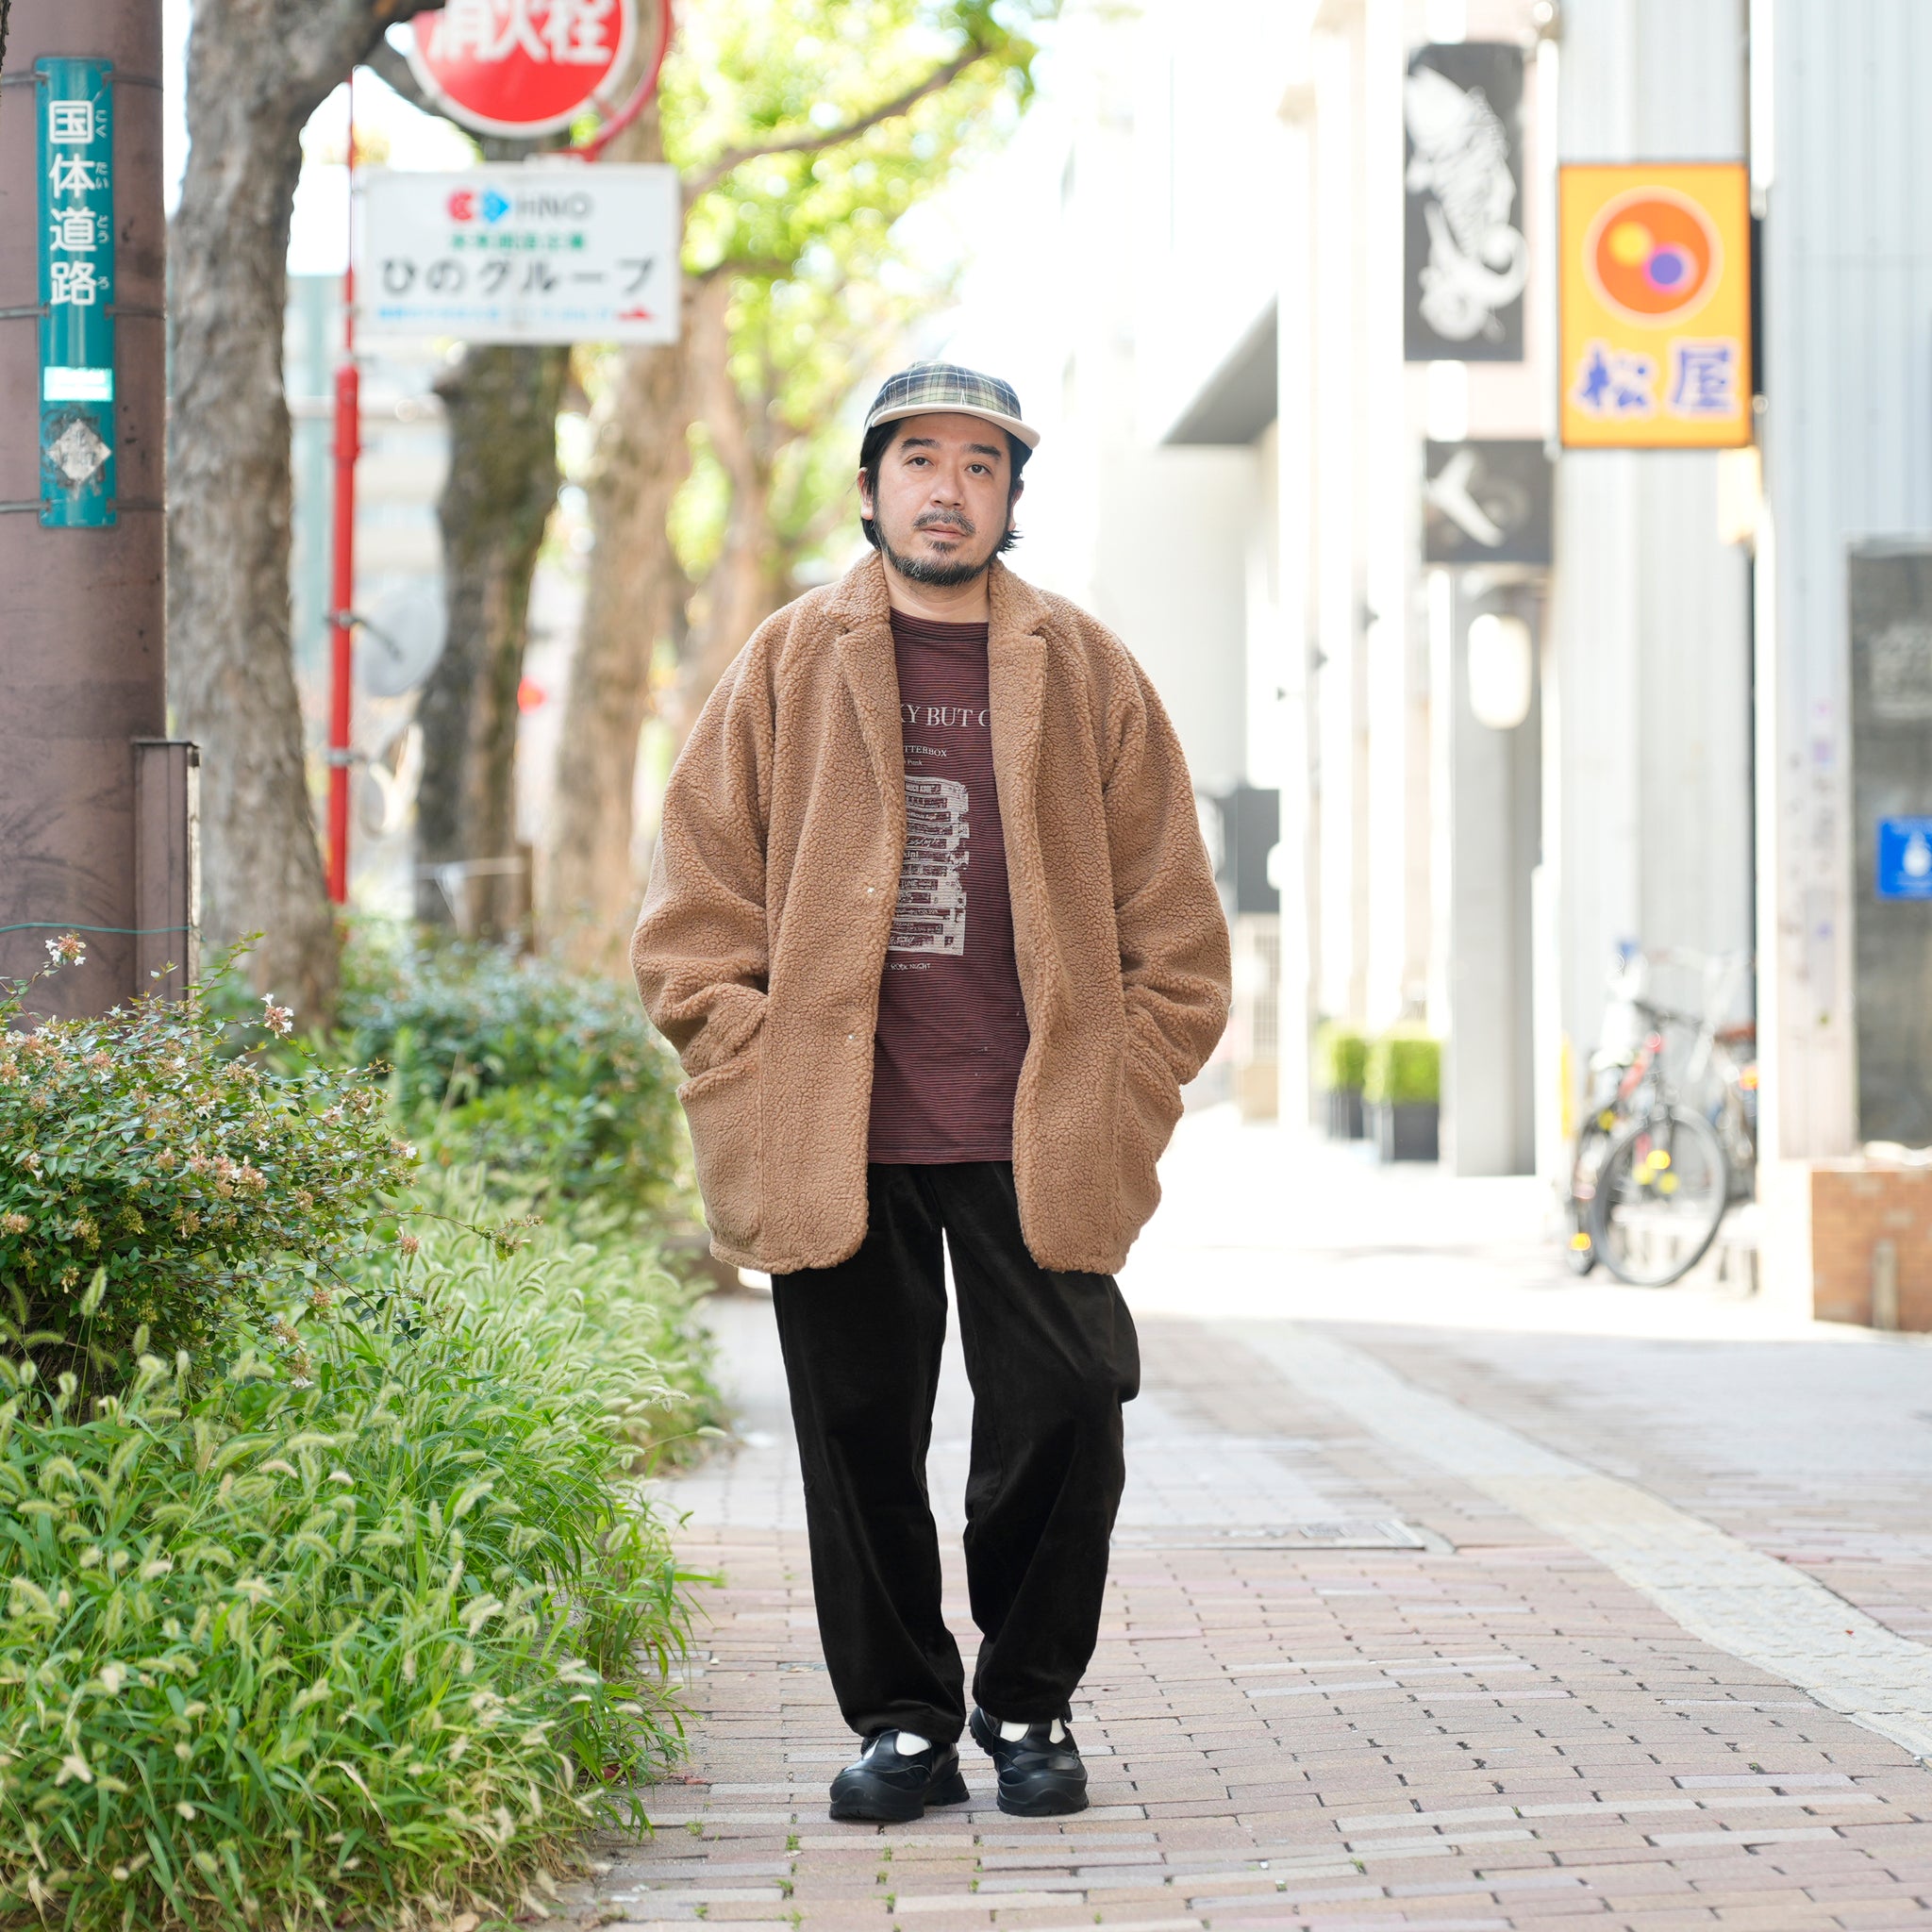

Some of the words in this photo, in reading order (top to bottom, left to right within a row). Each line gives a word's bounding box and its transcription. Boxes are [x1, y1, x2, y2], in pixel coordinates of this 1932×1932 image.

[95, 109, 108, 139] こく
[95, 161, 109, 190] たい
[48, 100, 96, 306] 国体道路
[1578, 347, 1734, 410] 松屋
[925, 706, 973, 727] BUT
